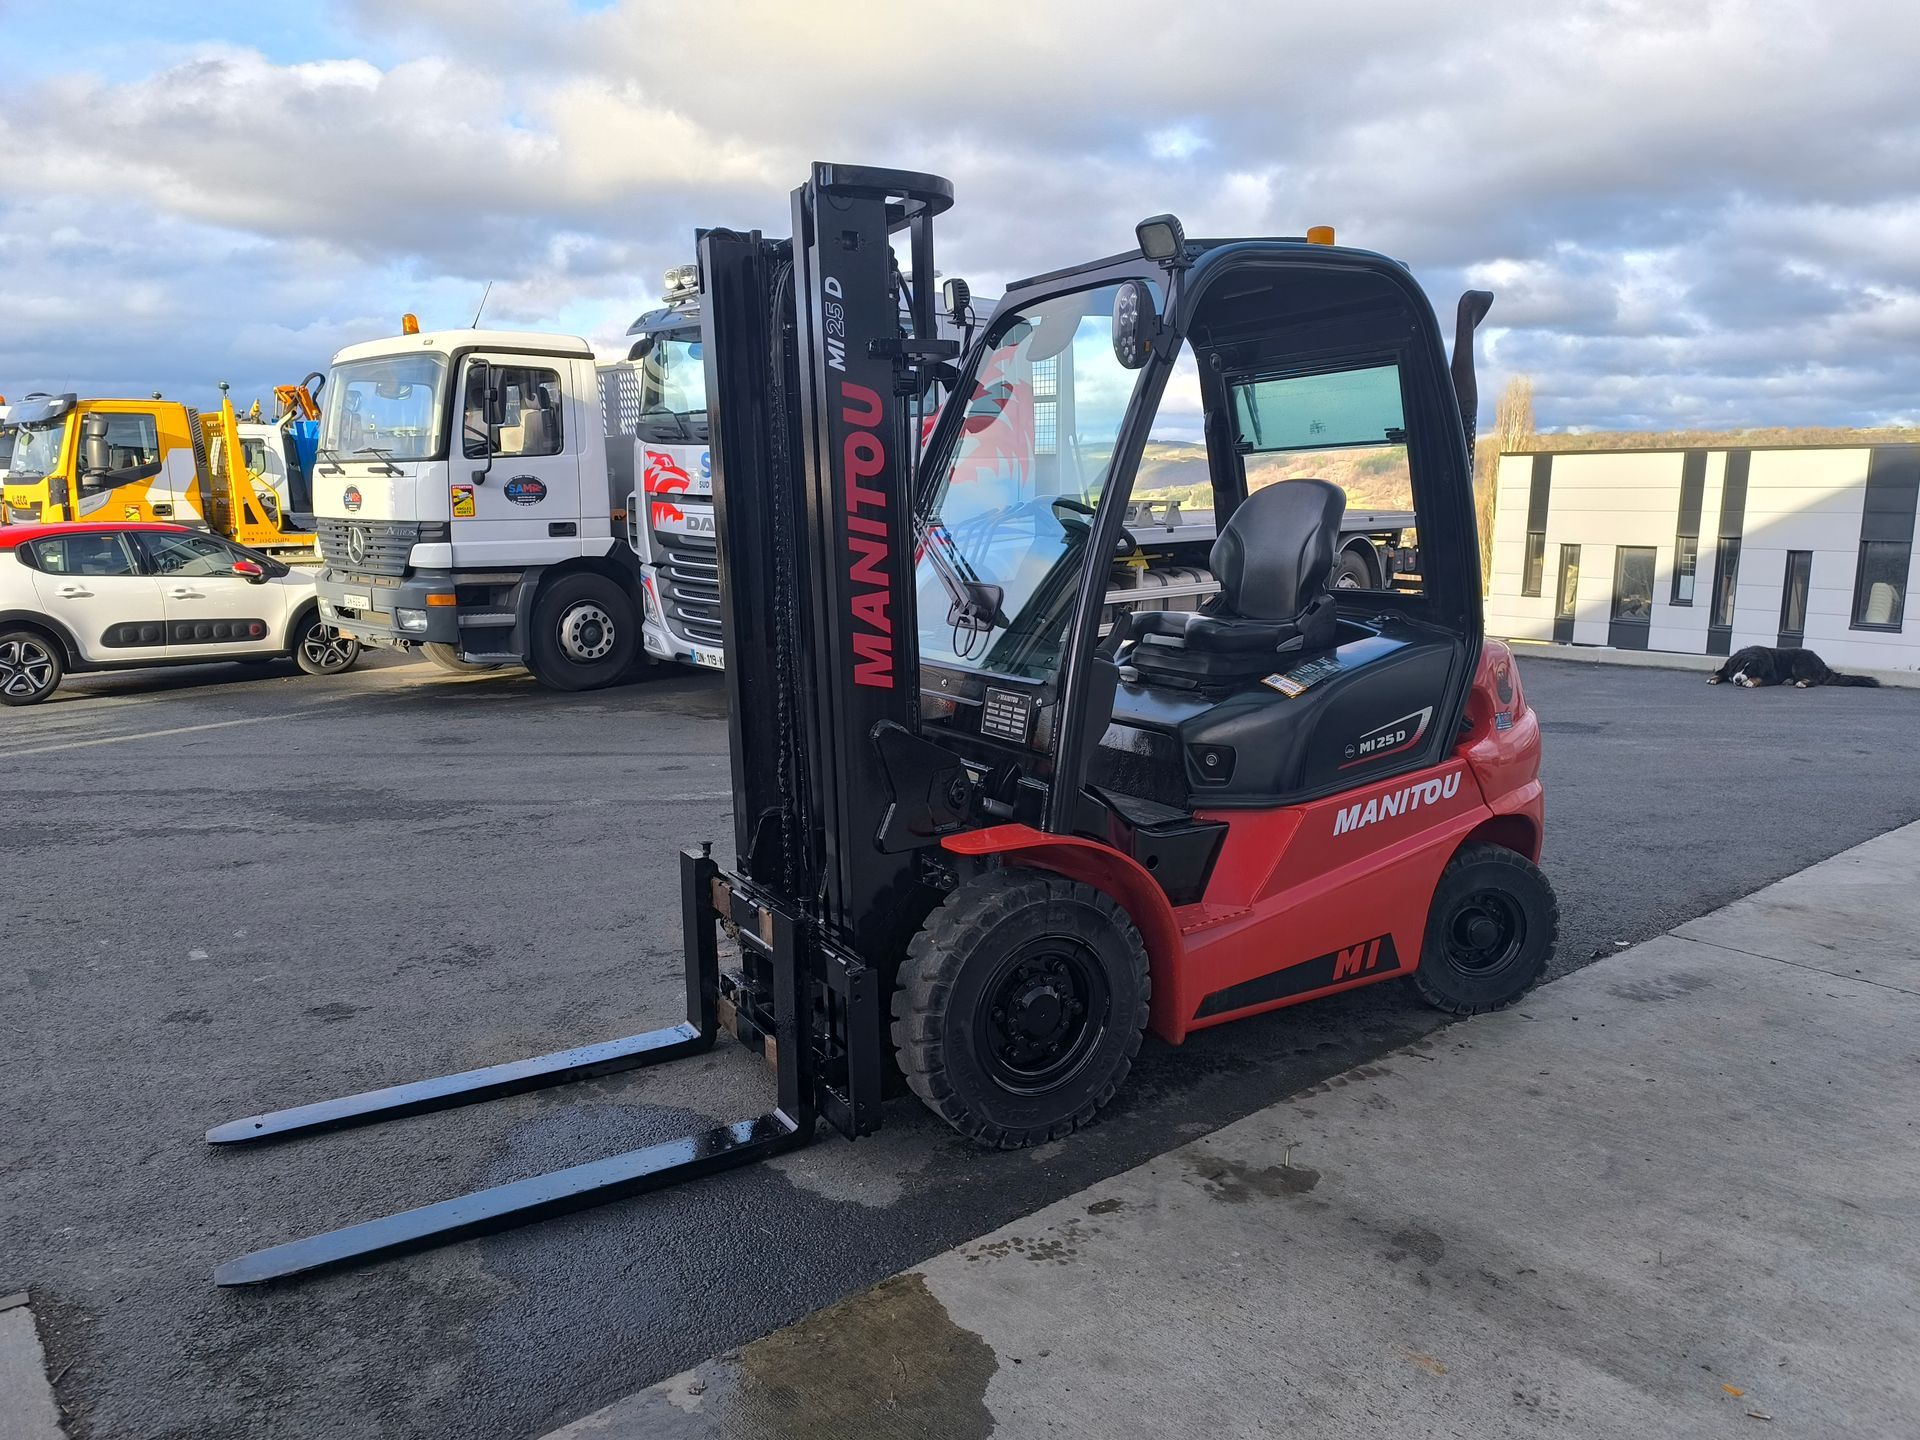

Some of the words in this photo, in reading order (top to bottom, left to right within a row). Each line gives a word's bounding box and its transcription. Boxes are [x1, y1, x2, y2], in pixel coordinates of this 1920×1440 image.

[686, 516, 716, 531] DA
[841, 381, 893, 688] MANITOU
[1333, 771, 1462, 837] MANITOU
[1332, 938, 1382, 981] MI
